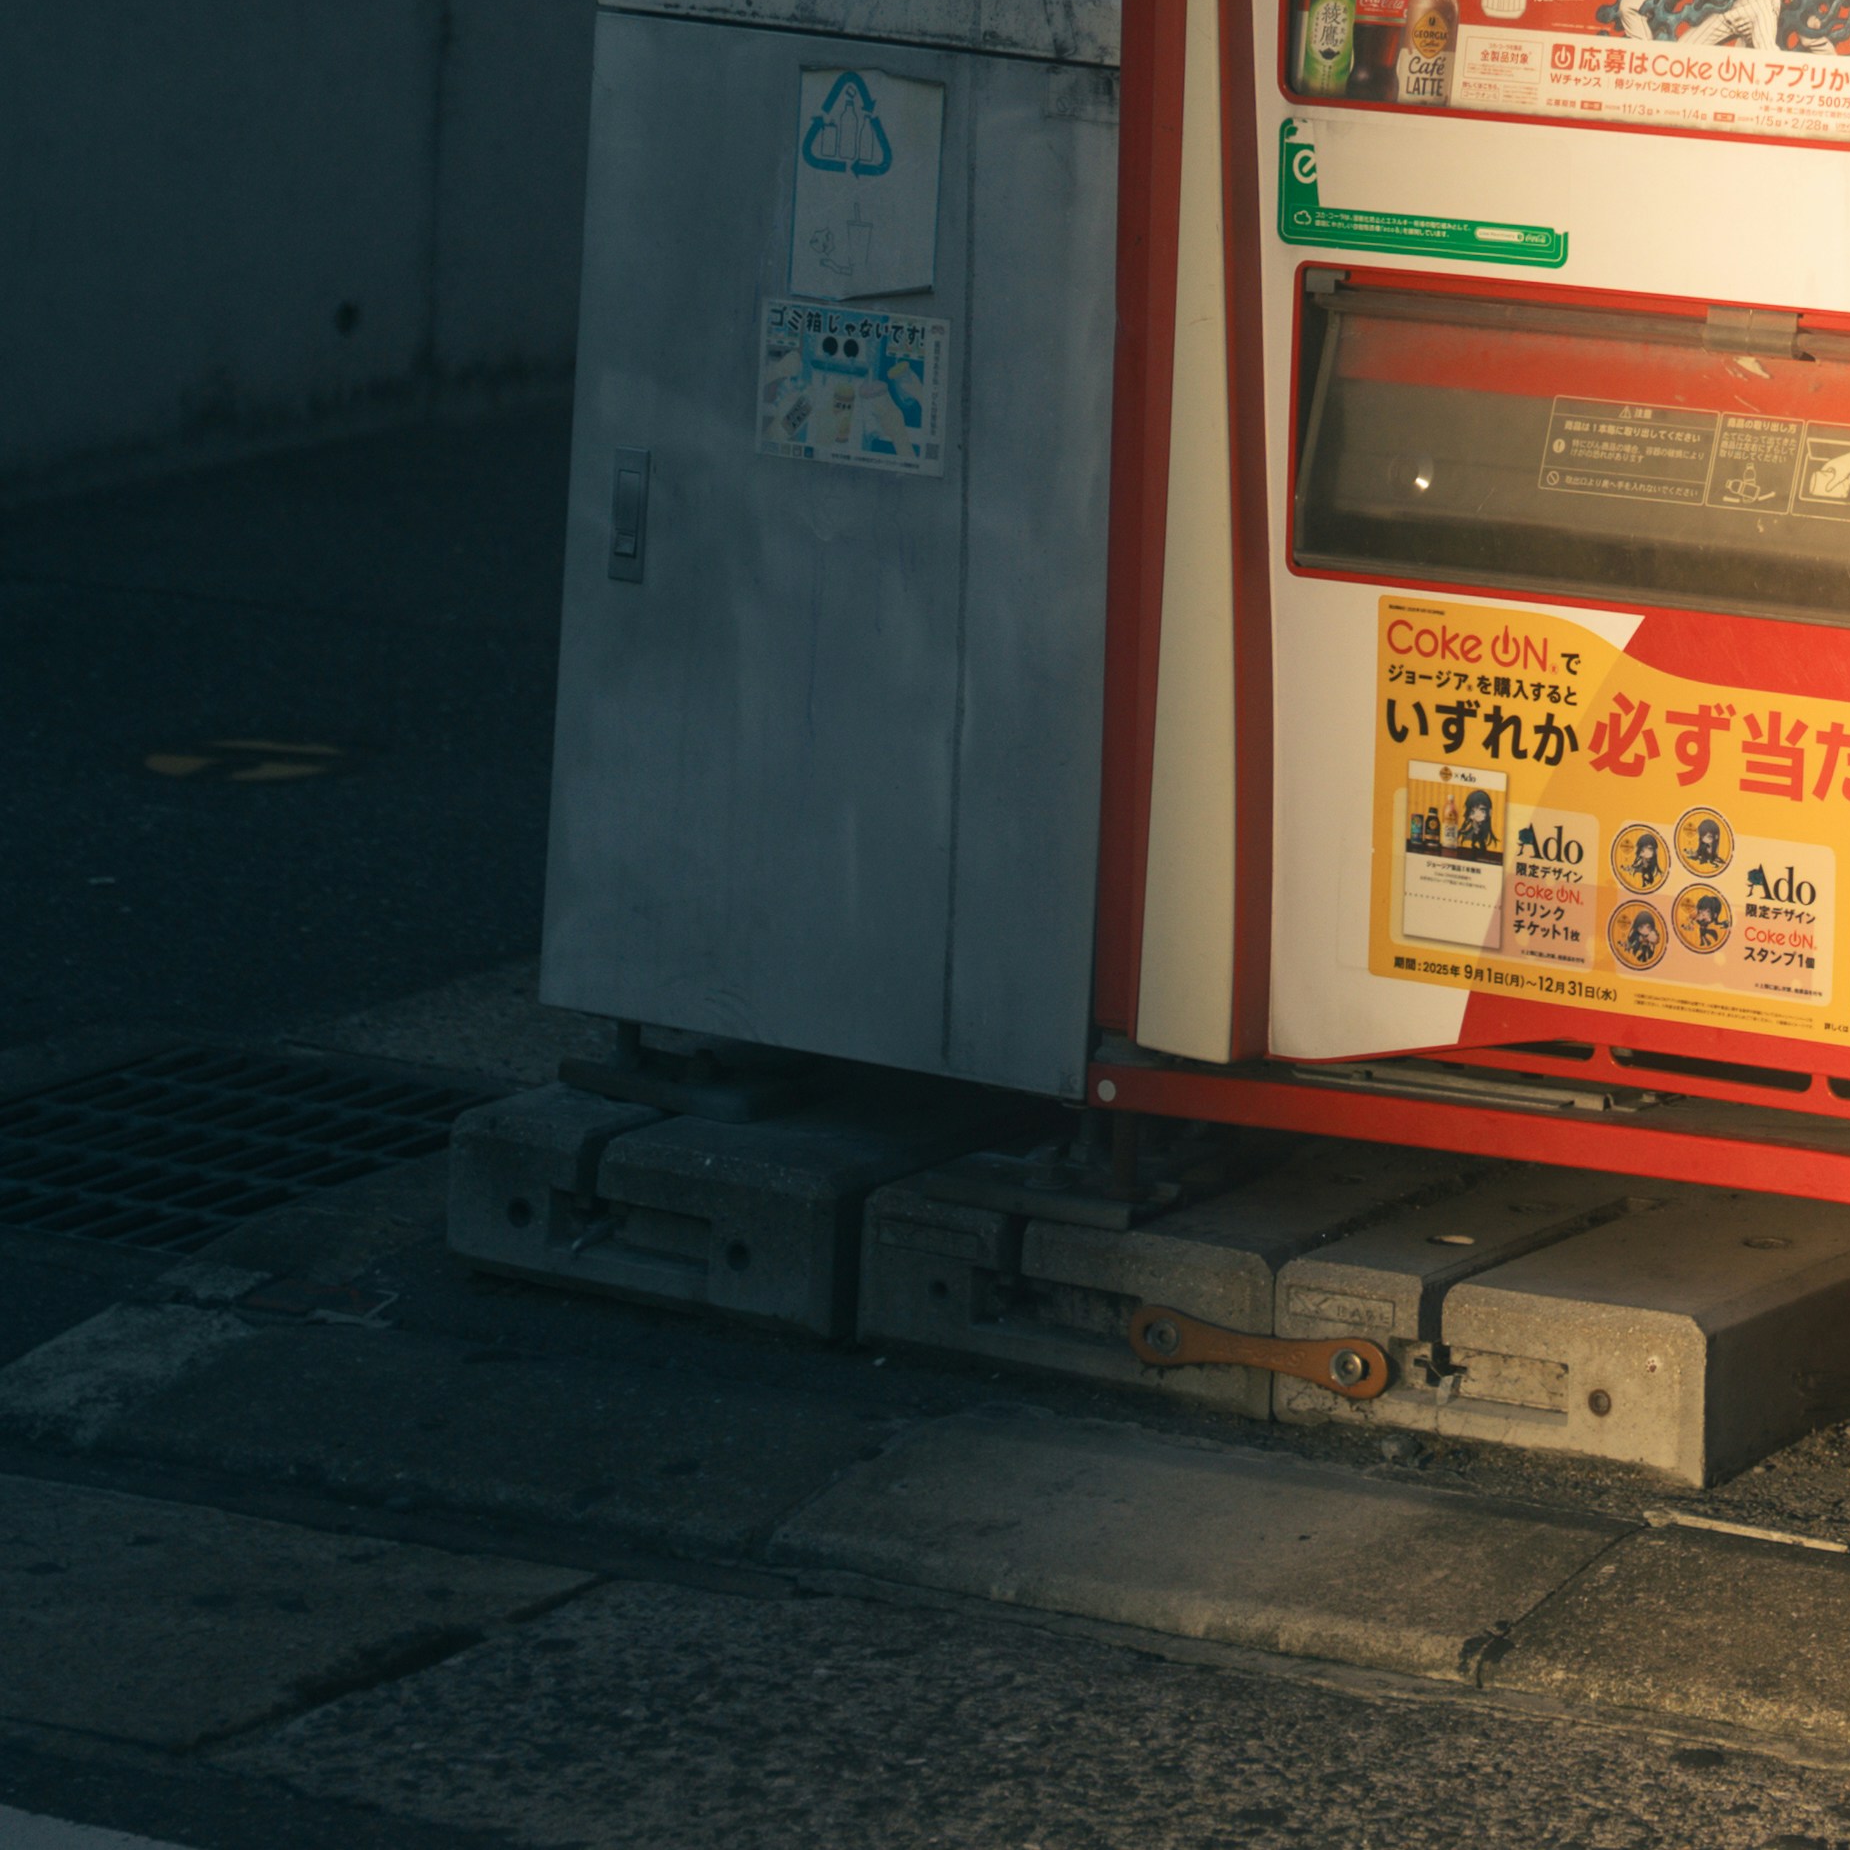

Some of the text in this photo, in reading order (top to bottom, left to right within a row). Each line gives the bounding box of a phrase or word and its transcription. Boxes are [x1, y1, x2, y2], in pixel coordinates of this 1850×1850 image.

[1408, 55, 1446, 77] Café
[1578, 47, 1648, 75] 応募は
[1651, 54, 1712, 81] Coke
[1405, 76, 1444, 97] LATTE
[1550, 73, 1601, 88] Wチャンス
[770, 306, 925, 346] ゴミ箱じゃないです!
[1387, 619, 1483, 665] Coke
[1385, 697, 1581, 767] いずれか
[1516, 821, 1585, 866] Ado
[1515, 863, 1585, 884] 限定デザイン
[1746, 863, 1817, 906] Ado
[1513, 881, 1554, 902] Coke
[1513, 901, 1565, 921] ドリンク
[1745, 904, 1817, 925] 限定デザイン
[1513, 920, 1581, 943] チケット1枚
[1743, 926, 1786, 947] Coke
[1743, 946, 1816, 971] スタンプ1個
